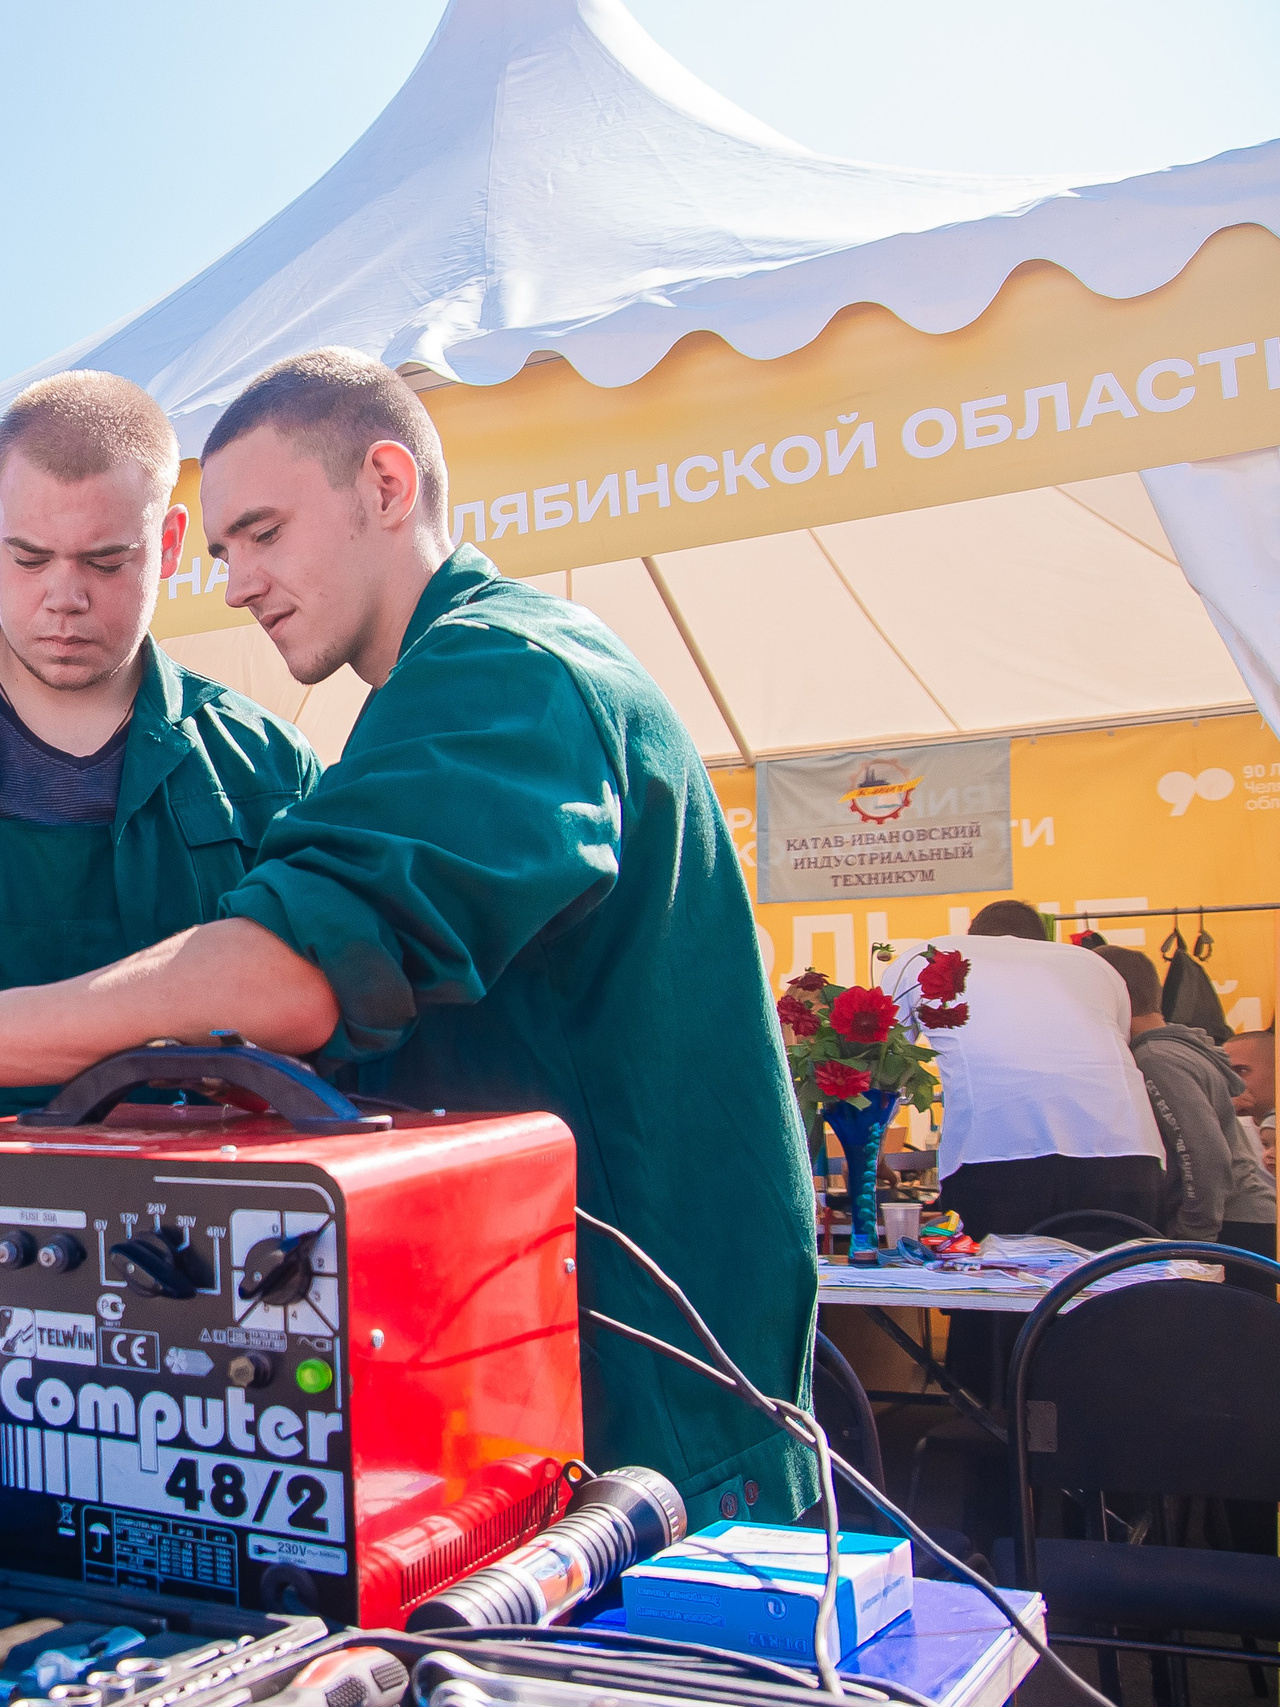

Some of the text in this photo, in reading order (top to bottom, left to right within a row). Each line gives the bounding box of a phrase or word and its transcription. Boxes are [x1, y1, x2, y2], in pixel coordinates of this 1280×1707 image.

[449, 411, 878, 546] ЛЯБИНСКОЙ
[1243, 763, 1266, 779] 90
[785, 820, 983, 853] КАТАВ-ИВАНОВСКИЙ
[792, 842, 974, 870] ИНДУСТРИАЛЬНЫЙ
[830, 867, 936, 888] ТЕХНИКУМ
[119, 1212, 139, 1225] 12V
[146, 1202, 167, 1215] 24V
[175, 1215, 197, 1228] 36V
[37, 1324, 95, 1351] TELWIN
[110, 1333, 148, 1367] CE
[0, 1357, 343, 1473] Computer
[165, 1457, 331, 1534] 48/2
[277, 1541, 307, 1557] 230V
